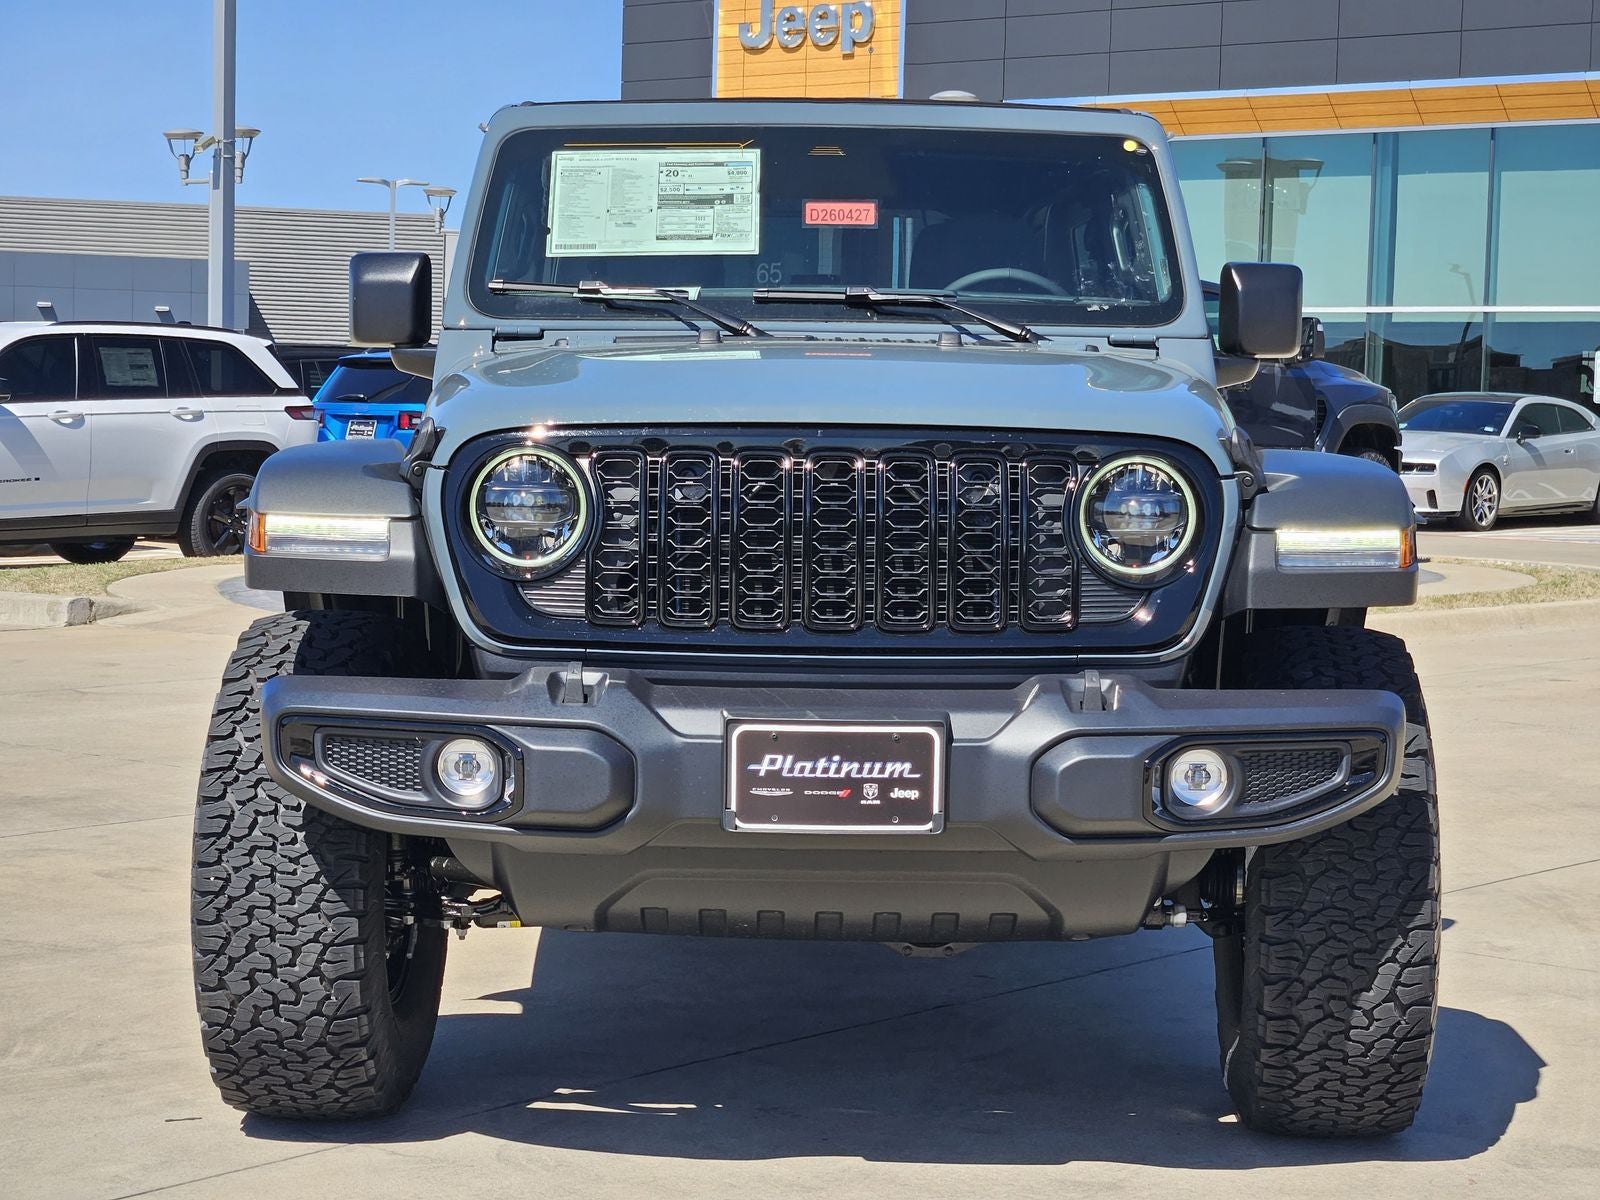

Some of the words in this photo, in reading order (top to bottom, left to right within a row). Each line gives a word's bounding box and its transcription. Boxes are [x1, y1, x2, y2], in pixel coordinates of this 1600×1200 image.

[738, 0, 876, 54] Jeep
[665, 169, 679, 178] 20
[810, 208, 871, 222] D260427
[747, 754, 921, 778] Platinum
[890, 787, 920, 800] Jeep
